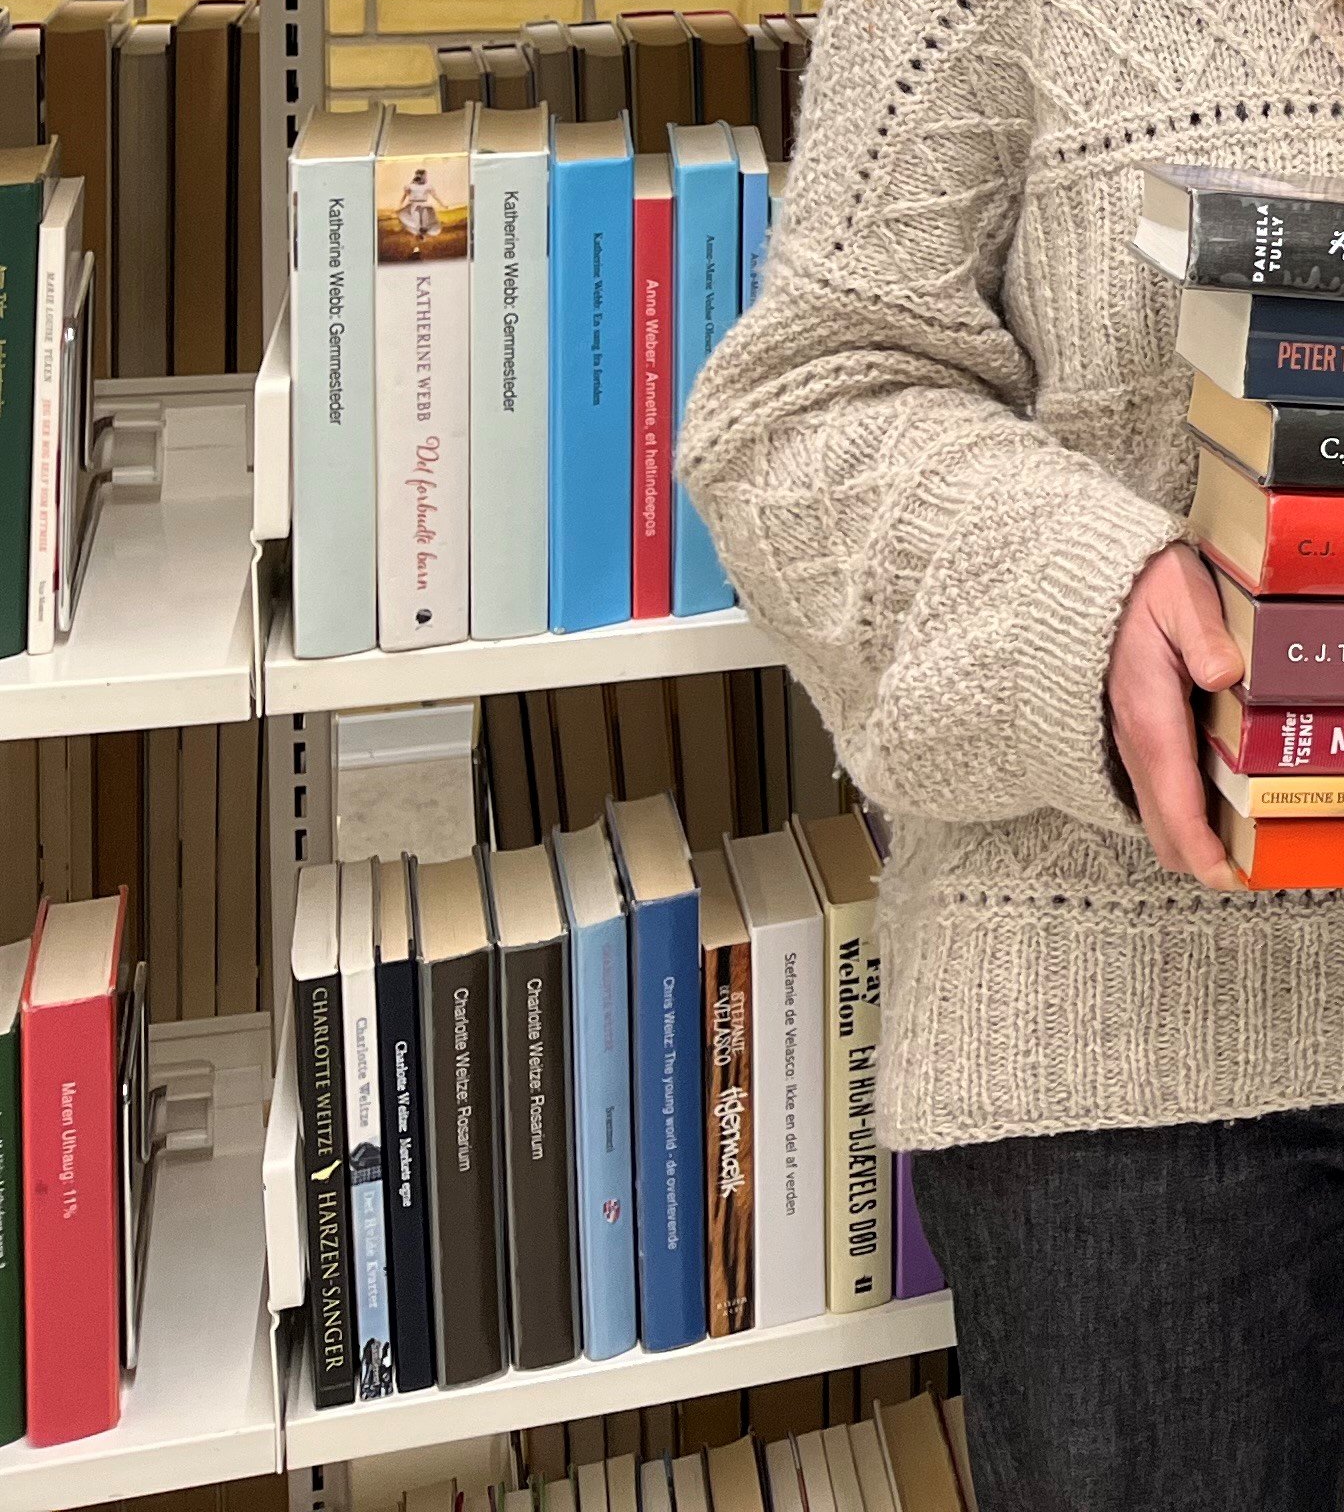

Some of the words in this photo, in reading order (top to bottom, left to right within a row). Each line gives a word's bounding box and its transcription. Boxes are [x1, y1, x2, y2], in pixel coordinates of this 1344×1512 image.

[328, 197, 345, 268] Katherine
[1252, 204, 1270, 283] DANIELA
[1268, 216, 1283, 273] TULLY
[415, 276, 432, 372] KATHERINE
[328, 322, 343, 427] Gemmesteder
[1278, 342, 1336, 372] PETER
[416, 377, 431, 422] WEBB
[404, 476, 437, 549] forbudte
[415, 551, 438, 592] barn
[1287, 644, 1308, 663] C.
[1314, 644, 1331, 664] J.
[1279, 711, 1296, 767] Jennifer
[1296, 713, 1313, 766] TSENG
[1261, 790, 1333, 805] CHRISTINE
[527, 979, 540, 1037] Charlotte
[312, 988, 330, 1088] CHARLOTTE
[316, 1093, 333, 1158] WEITZE
[530, 1097, 544, 1160] Rosarium
[62, 1188, 77, 1219] 11%
[319, 1192, 344, 1372] HARZEN-SANGER
